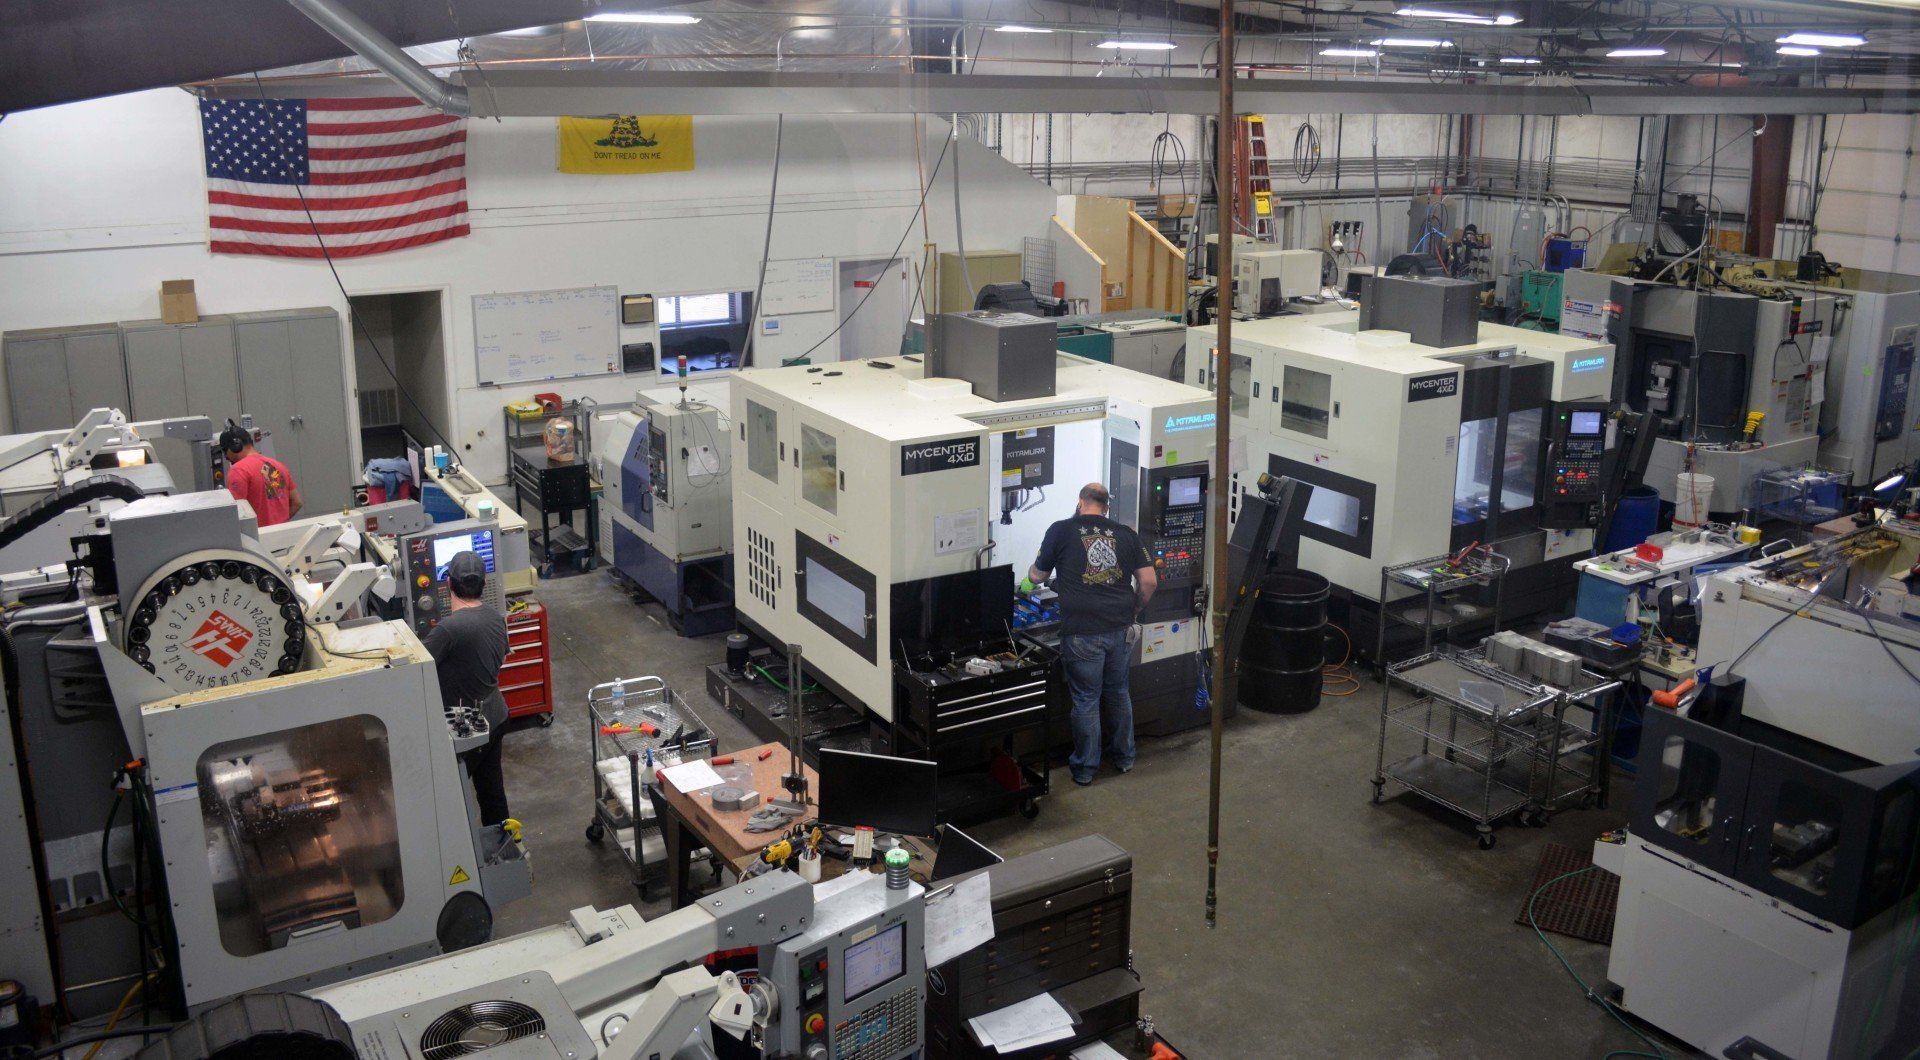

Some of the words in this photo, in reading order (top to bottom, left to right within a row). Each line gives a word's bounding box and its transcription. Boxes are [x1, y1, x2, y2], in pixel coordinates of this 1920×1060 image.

[594, 152, 613, 160] DONT
[615, 152, 637, 160] TREAD
[640, 152, 650, 160] ON
[1411, 377, 1455, 390] MYCENTER
[1176, 413, 1217, 426] KITAMURA
[905, 443, 975, 460] MYCENTER
[1006, 447, 1046, 458] KITAMURA
[222, 592, 229, 604] 3
[233, 594, 242, 606] 2
[185, 603, 196, 613] 6
[243, 600, 251, 610] 1
[176, 611, 187, 621] 7
[249, 607, 263, 619] 24
[169, 622, 182, 630] 8
[255, 617, 269, 628] 23
[259, 628, 272, 638] 22
[165, 644, 178, 653] 10
[258, 639, 271, 648] 21
[169, 654, 180, 663] 11
[254, 649, 268, 660] 20
[175, 663, 187, 674] 12
[249, 658, 261, 670] 19
[184, 669, 196, 681] 13
[231, 672, 240, 683] 17
[241, 667, 252, 677] 18
[196, 675, 205, 685] 14
[208, 677, 215, 688] 15
[220, 676, 228, 686] 16
